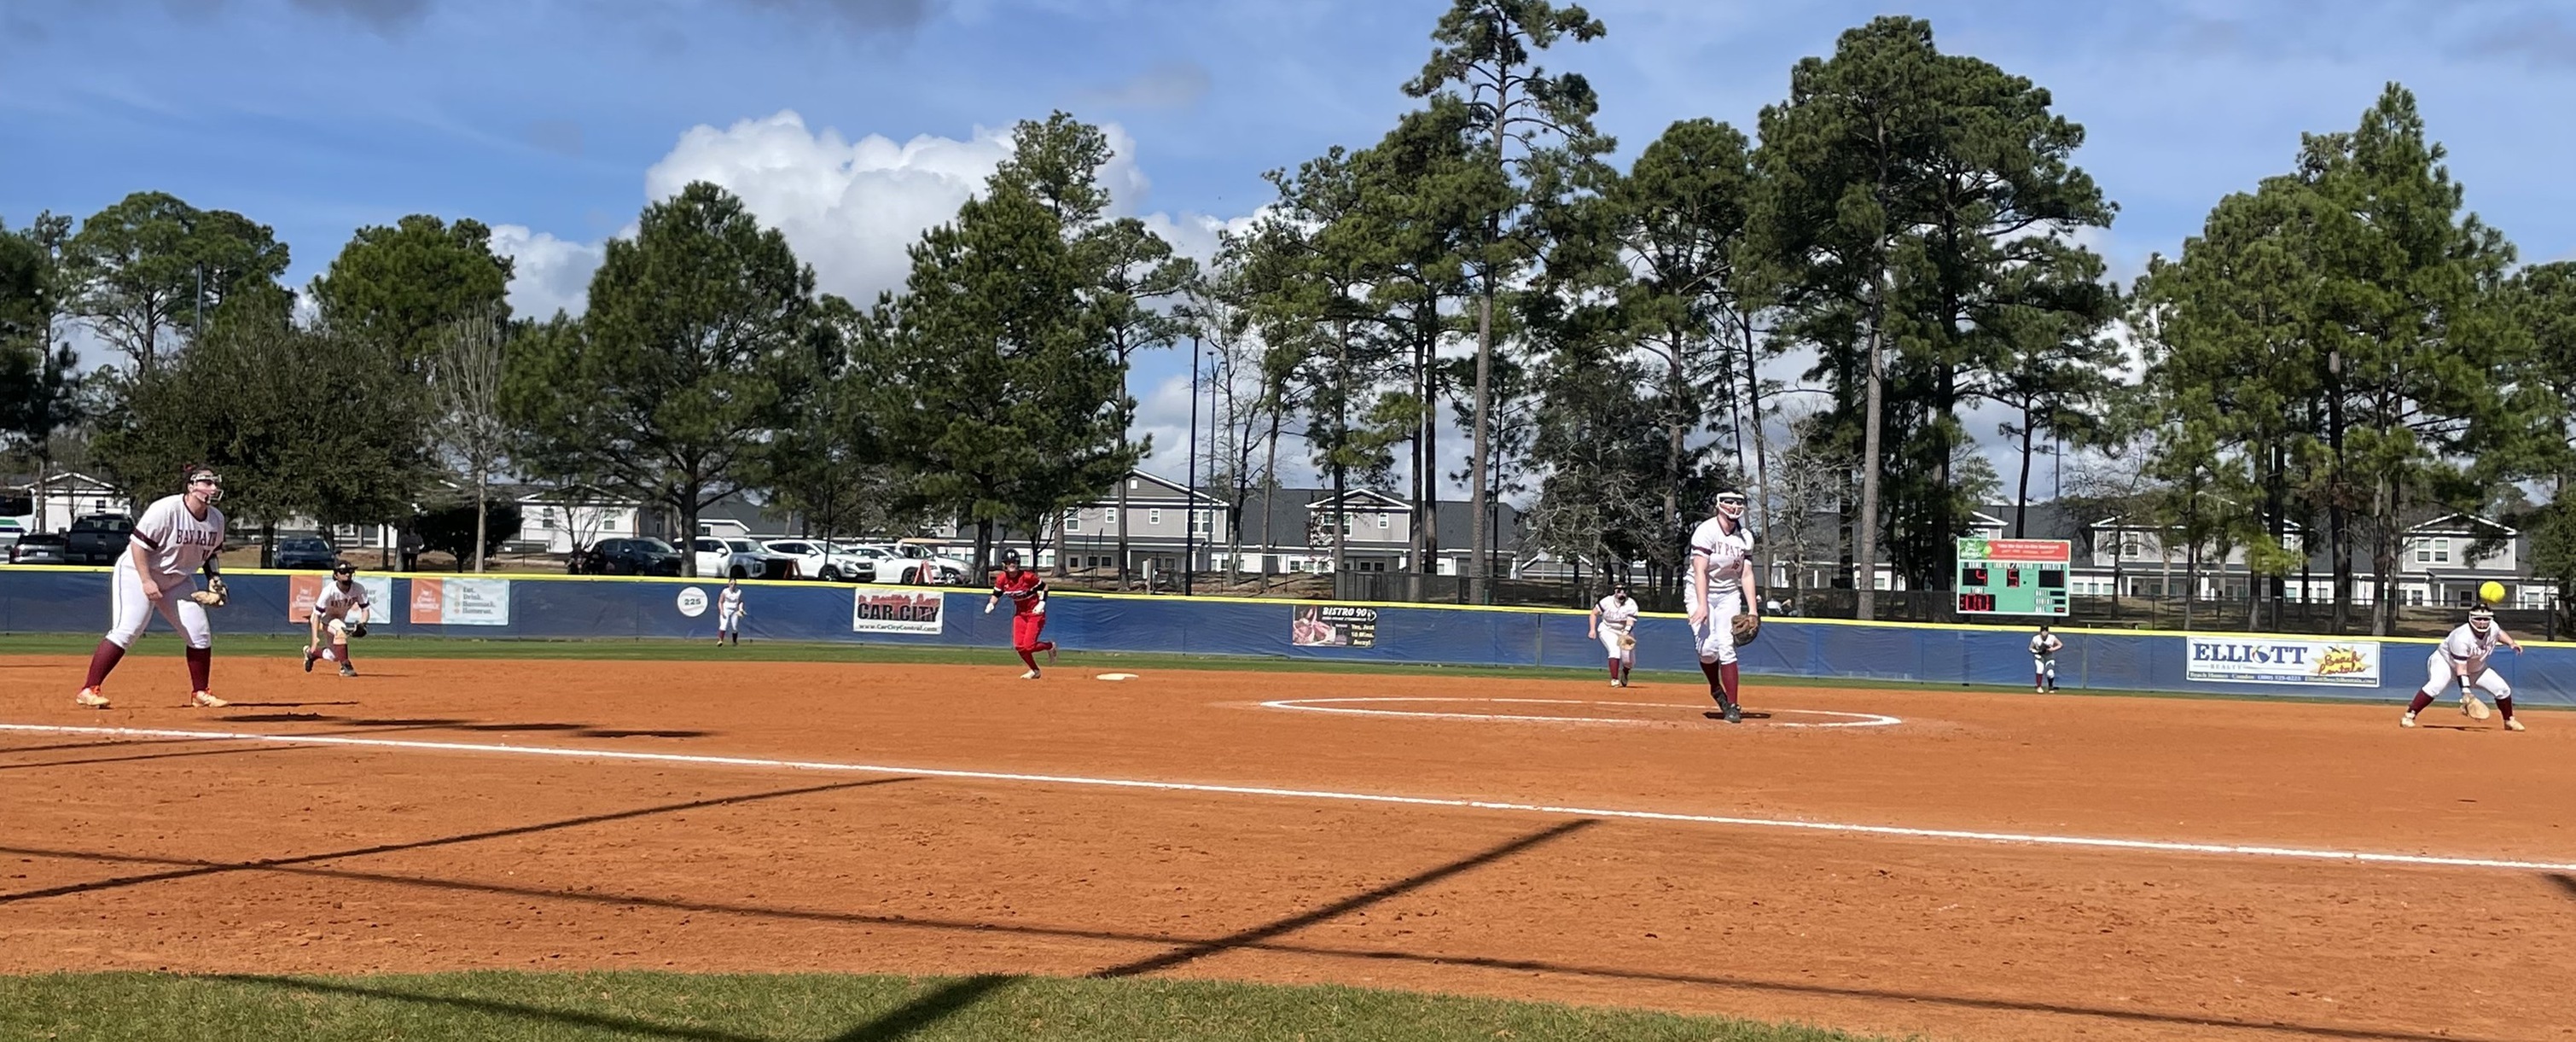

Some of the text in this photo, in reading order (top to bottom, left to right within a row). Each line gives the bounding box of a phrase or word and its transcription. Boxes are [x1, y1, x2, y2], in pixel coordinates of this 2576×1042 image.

[176, 529, 195, 544] BAY
[858, 602, 939, 622] CAR CITY
[1323, 607, 1368, 617] BISTRO 90
[2193, 643, 2308, 665] ELLIOTT
[2324, 650, 2361, 667] Beach
[2317, 663, 2367, 677] Rentals
